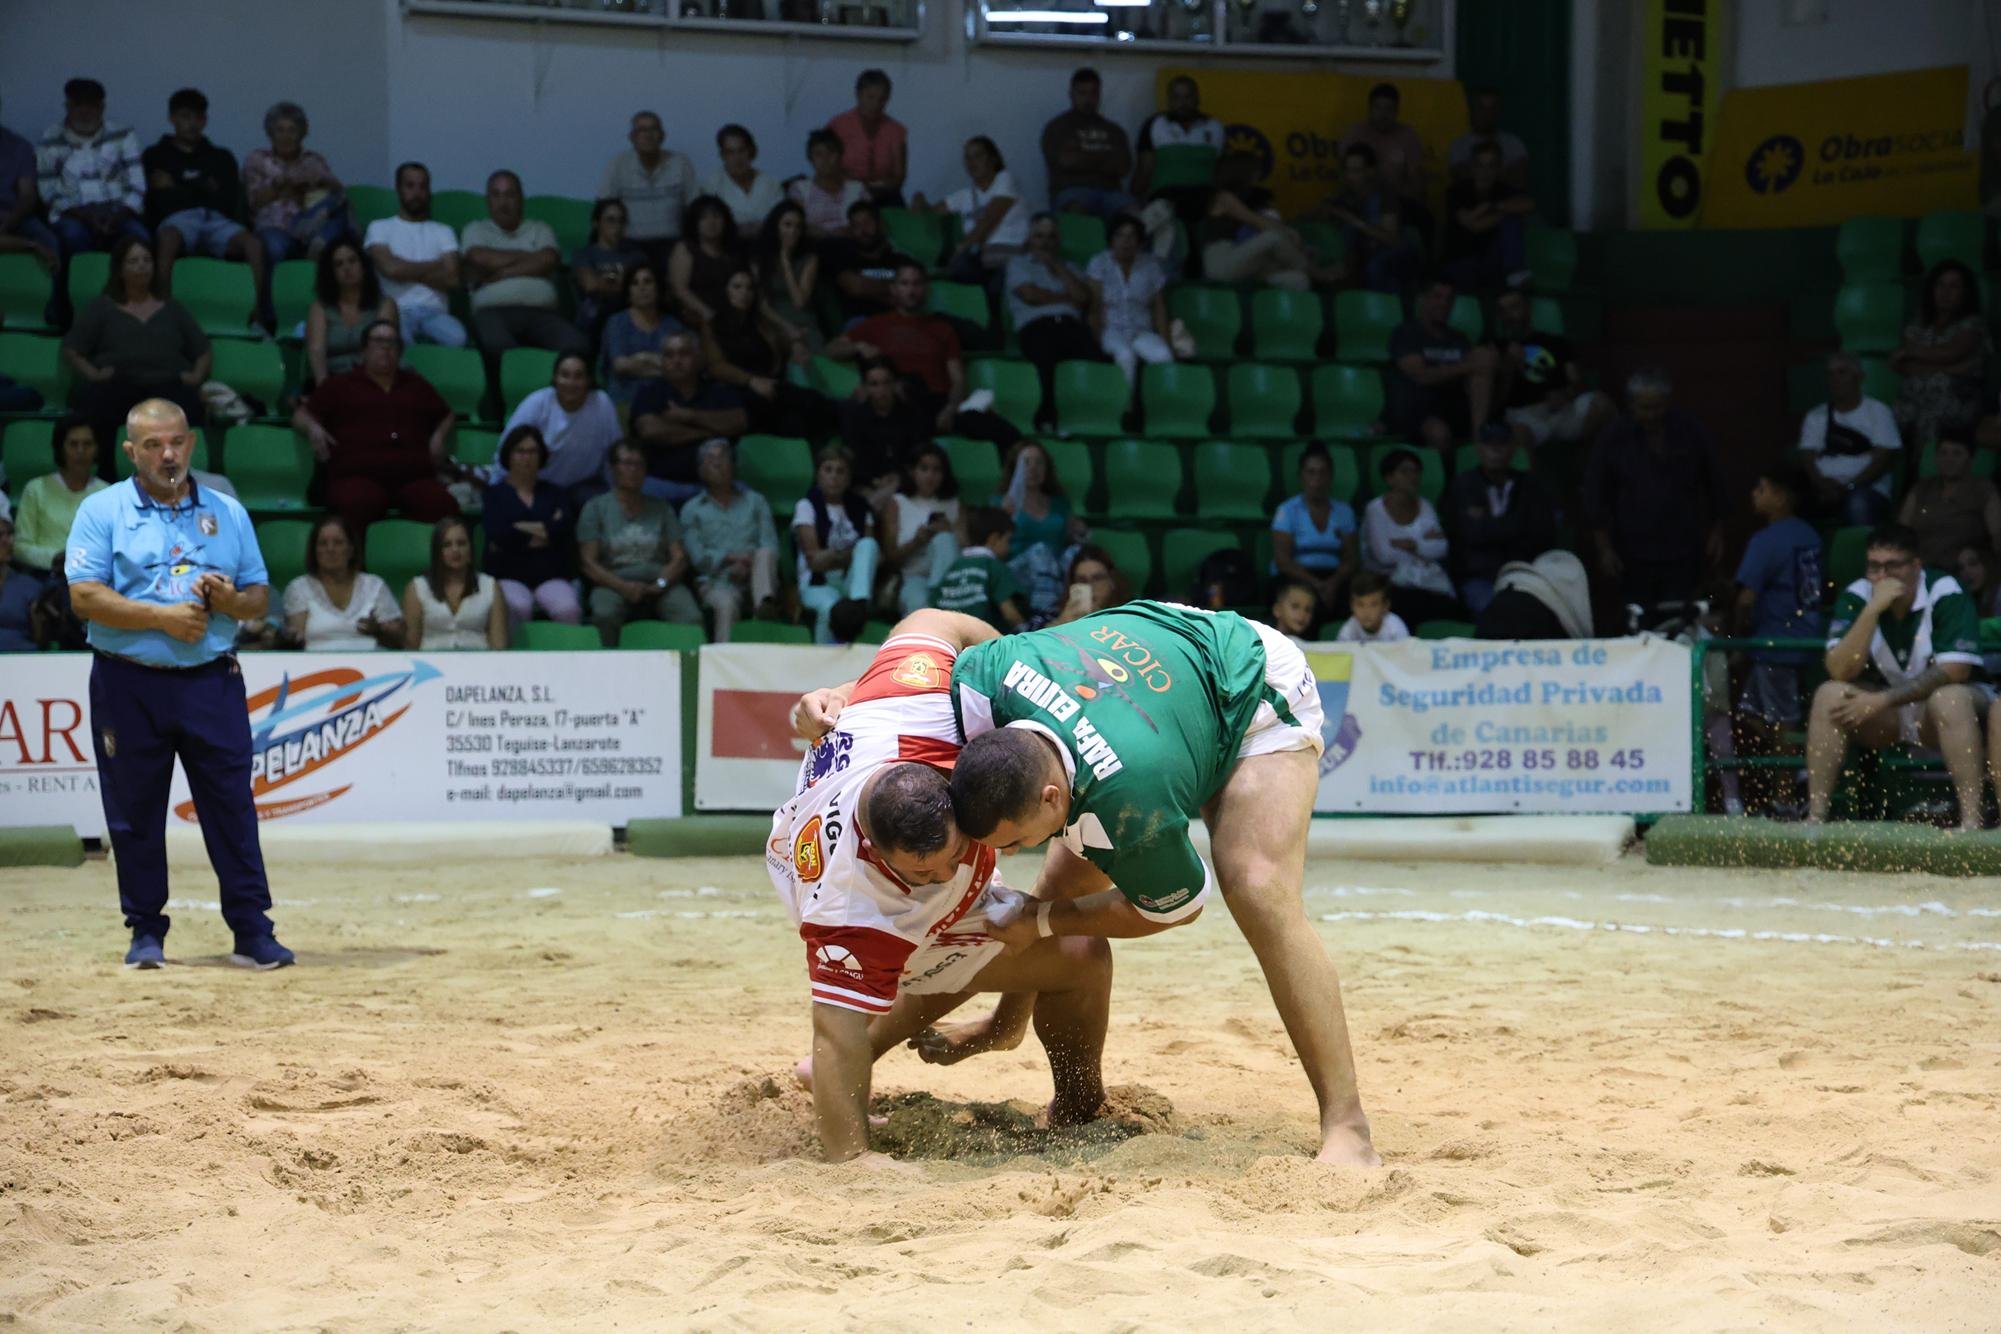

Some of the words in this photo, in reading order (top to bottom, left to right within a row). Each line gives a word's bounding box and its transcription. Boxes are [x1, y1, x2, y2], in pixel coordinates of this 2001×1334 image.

[1819, 133, 1892, 164] Obra
[1090, 625, 1172, 693] CICAR
[1431, 646, 1562, 672] Empresa
[1572, 643, 1607, 666] de
[532, 685, 556, 702] S.L.
[1003, 660, 1081, 723] ELVIRA
[1379, 681, 1531, 713] Seguridad
[1541, 681, 1663, 705] Privada
[446, 711, 464, 728] C/
[1430, 722, 1466, 746] de
[1475, 720, 1609, 744] Canarias
[251, 700, 384, 789] PELANZA
[446, 735, 492, 752] 35530
[1072, 716, 1124, 781] RAFA
[1522, 749, 1556, 770] 85
[1567, 749, 1600, 770] 88
[1610, 749, 1645, 770] 45
[28, 775, 80, 793] RENT
[1368, 775, 1672, 798] info@atlantisegur.com
